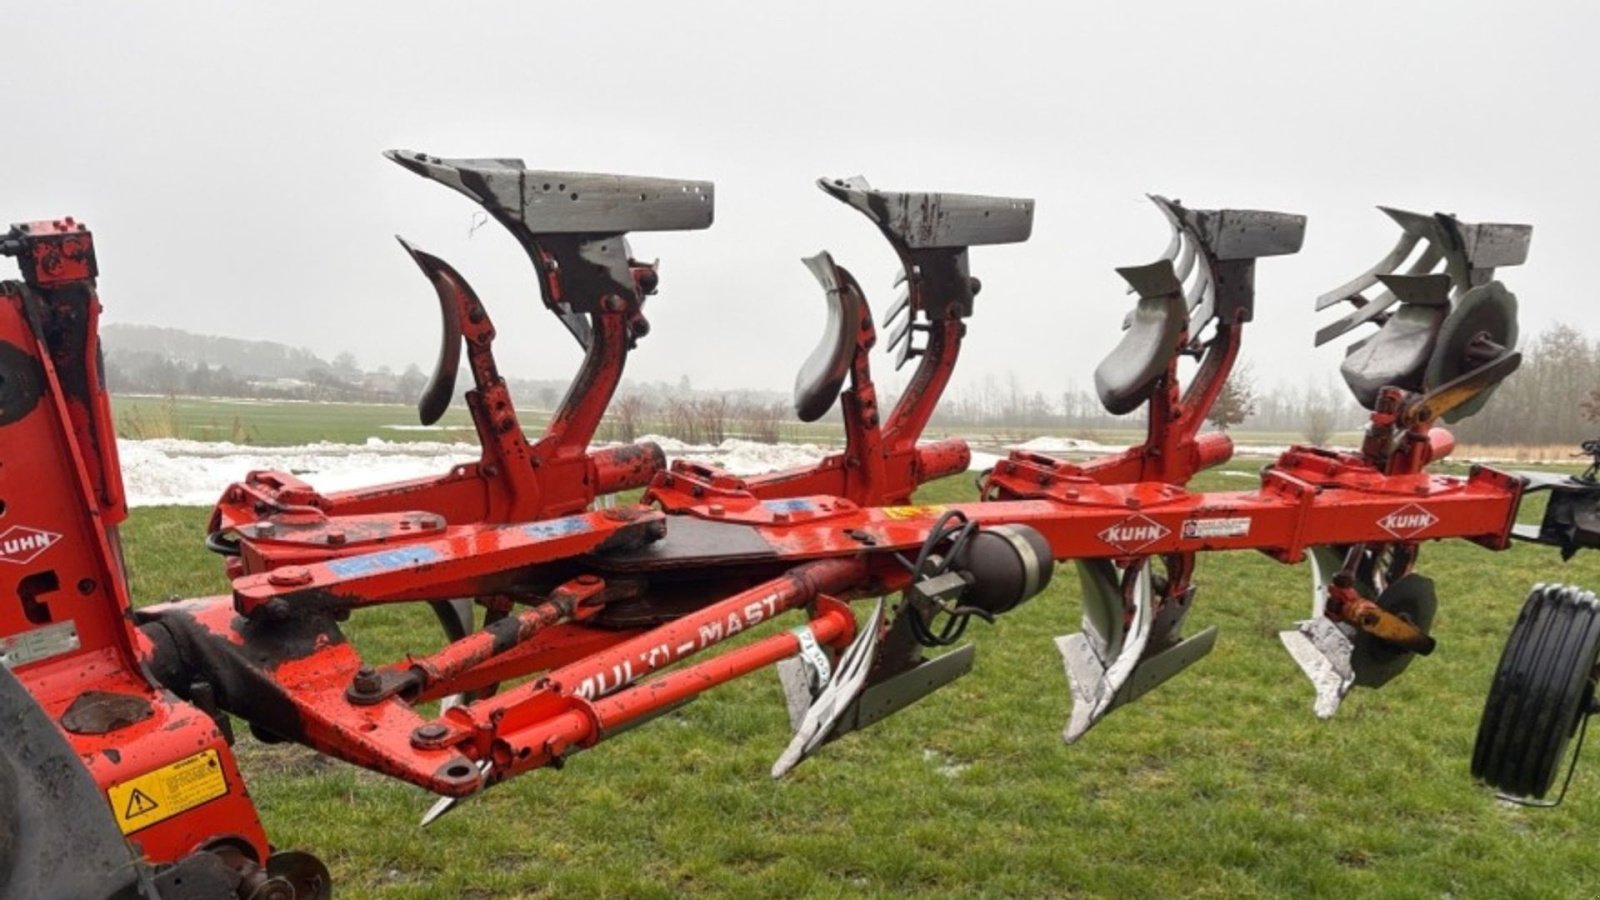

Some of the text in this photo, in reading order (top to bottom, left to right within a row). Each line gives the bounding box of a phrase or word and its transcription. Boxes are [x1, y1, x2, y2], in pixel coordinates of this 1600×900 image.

[1385, 513, 1430, 528] KUHN
[1107, 525, 1161, 541] KUHN
[0, 532, 50, 555] UHN
